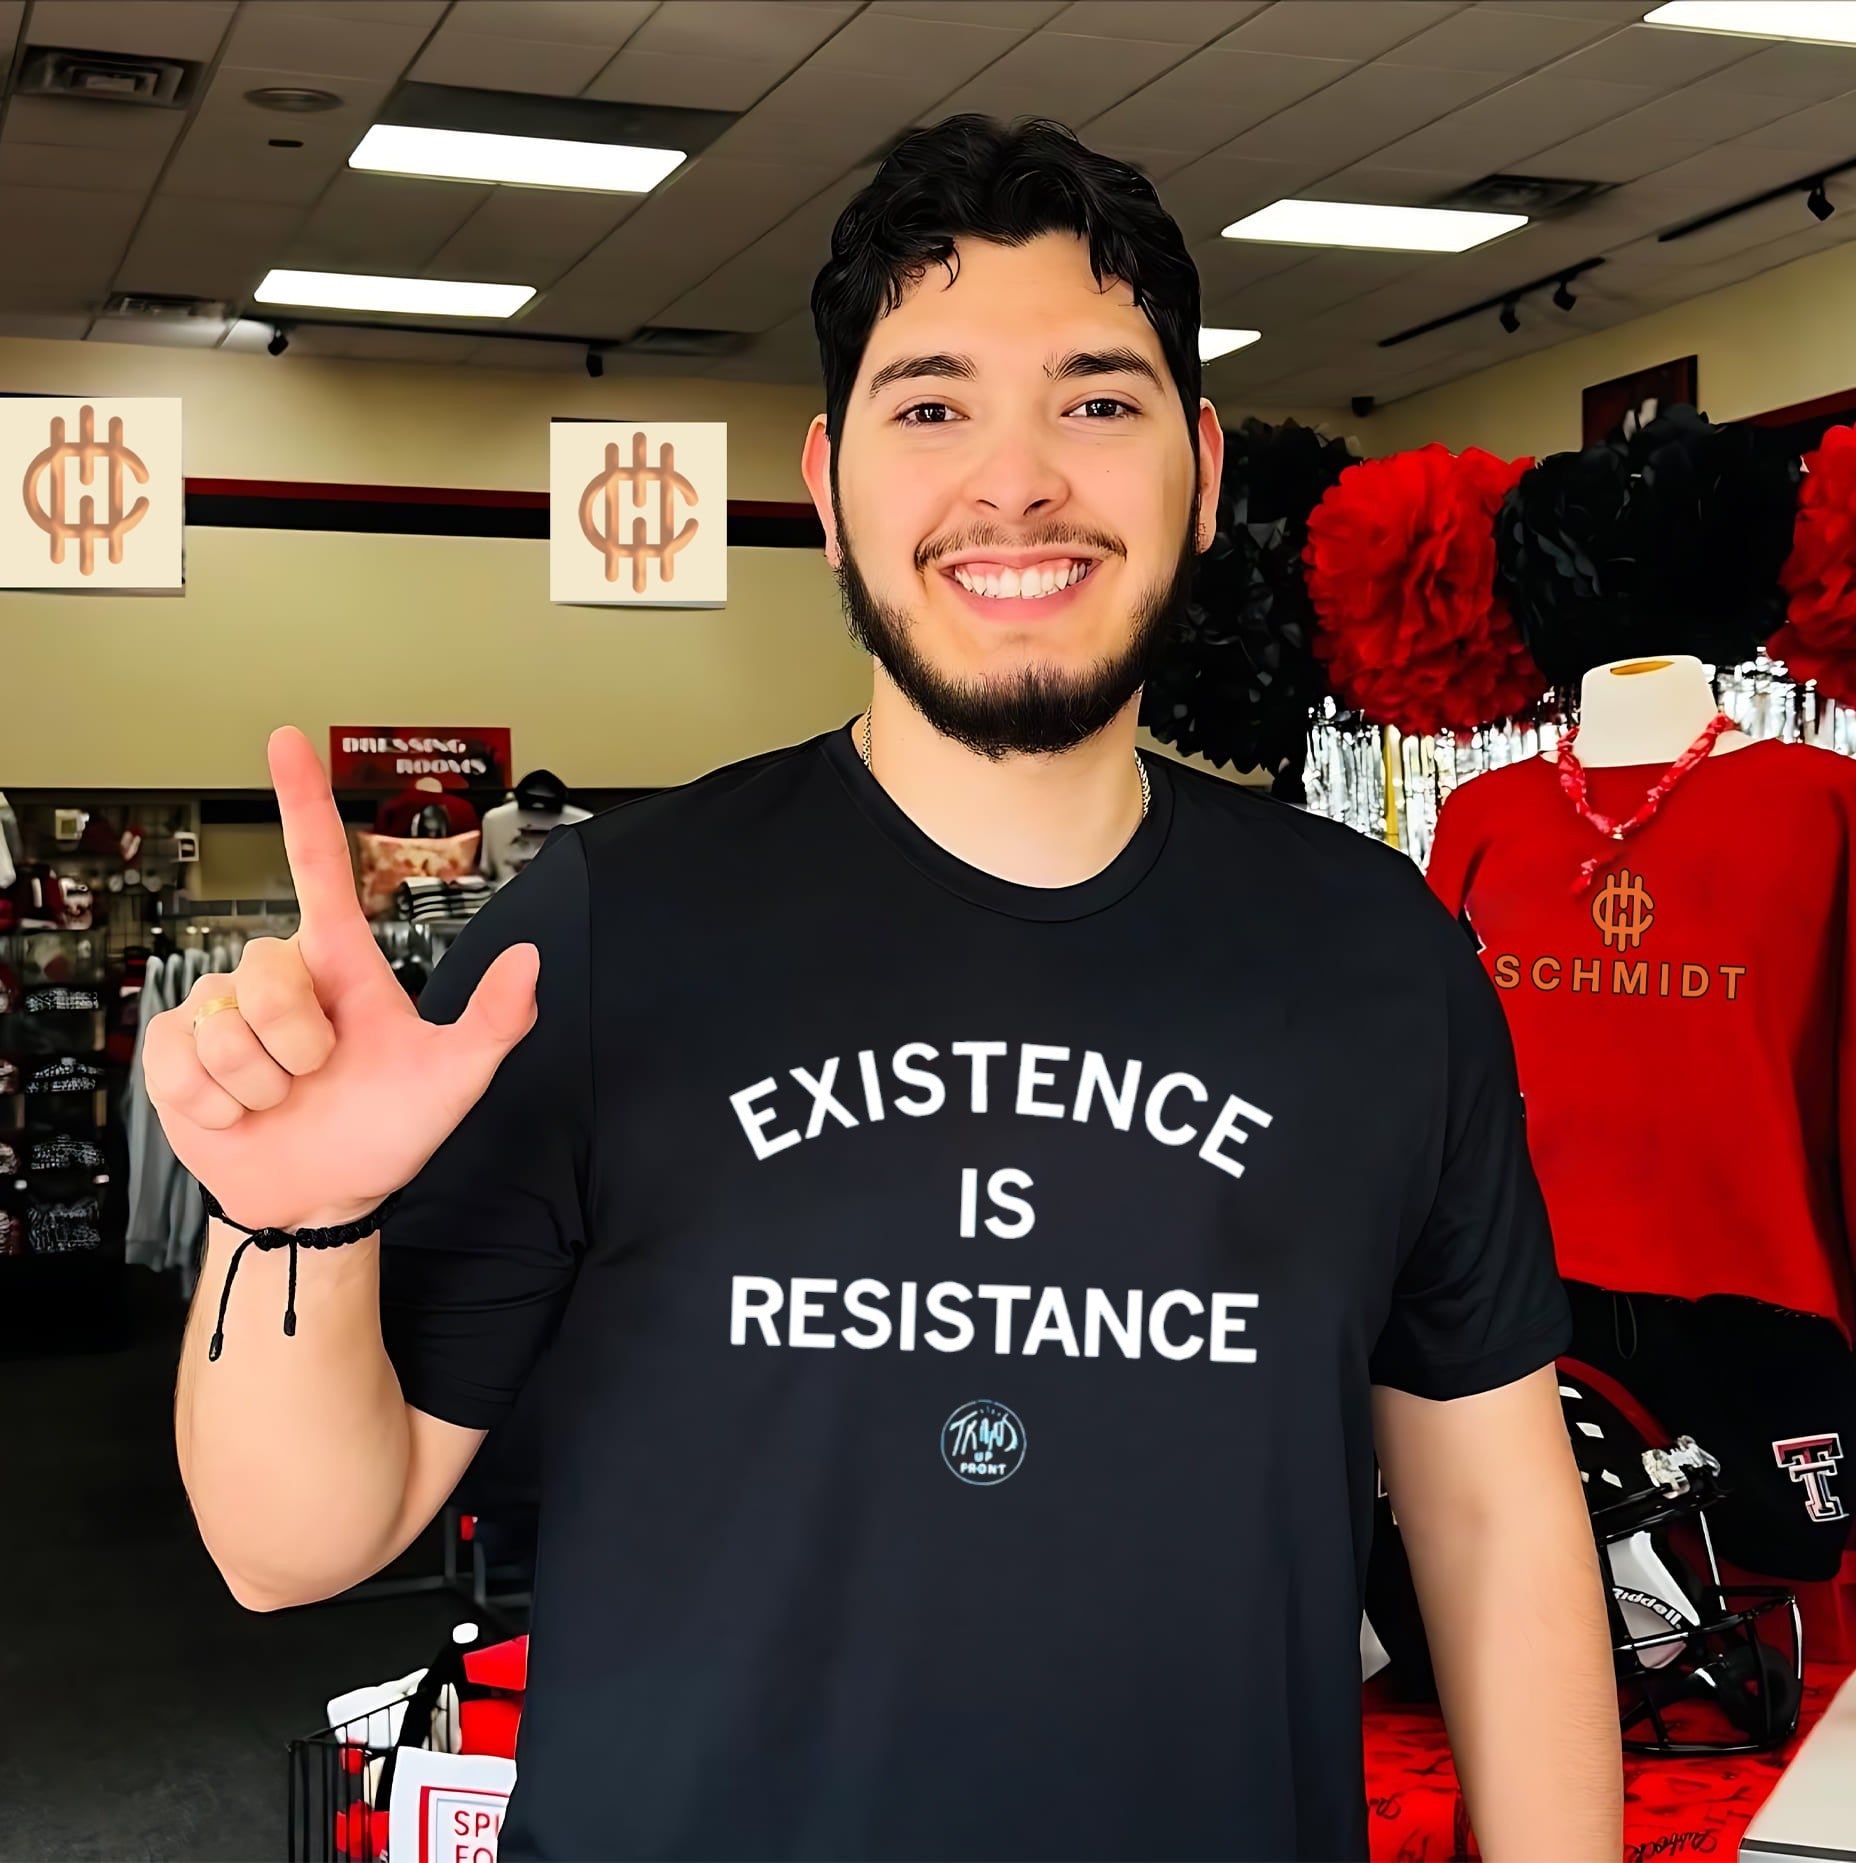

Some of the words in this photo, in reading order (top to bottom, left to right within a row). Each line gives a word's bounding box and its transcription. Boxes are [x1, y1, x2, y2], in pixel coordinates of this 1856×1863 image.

[342, 737, 467, 753] DRESSING
[396, 758, 487, 775] ROOMS
[1494, 954, 1747, 1000] SCHMIDT
[729, 1041, 1274, 1179] EXISTENCE
[959, 1168, 1036, 1240] IS
[729, 1275, 1260, 1363] RESISTANCE
[959, 1462, 1007, 1475] FRONT
[973, 1451, 994, 1463] UP
